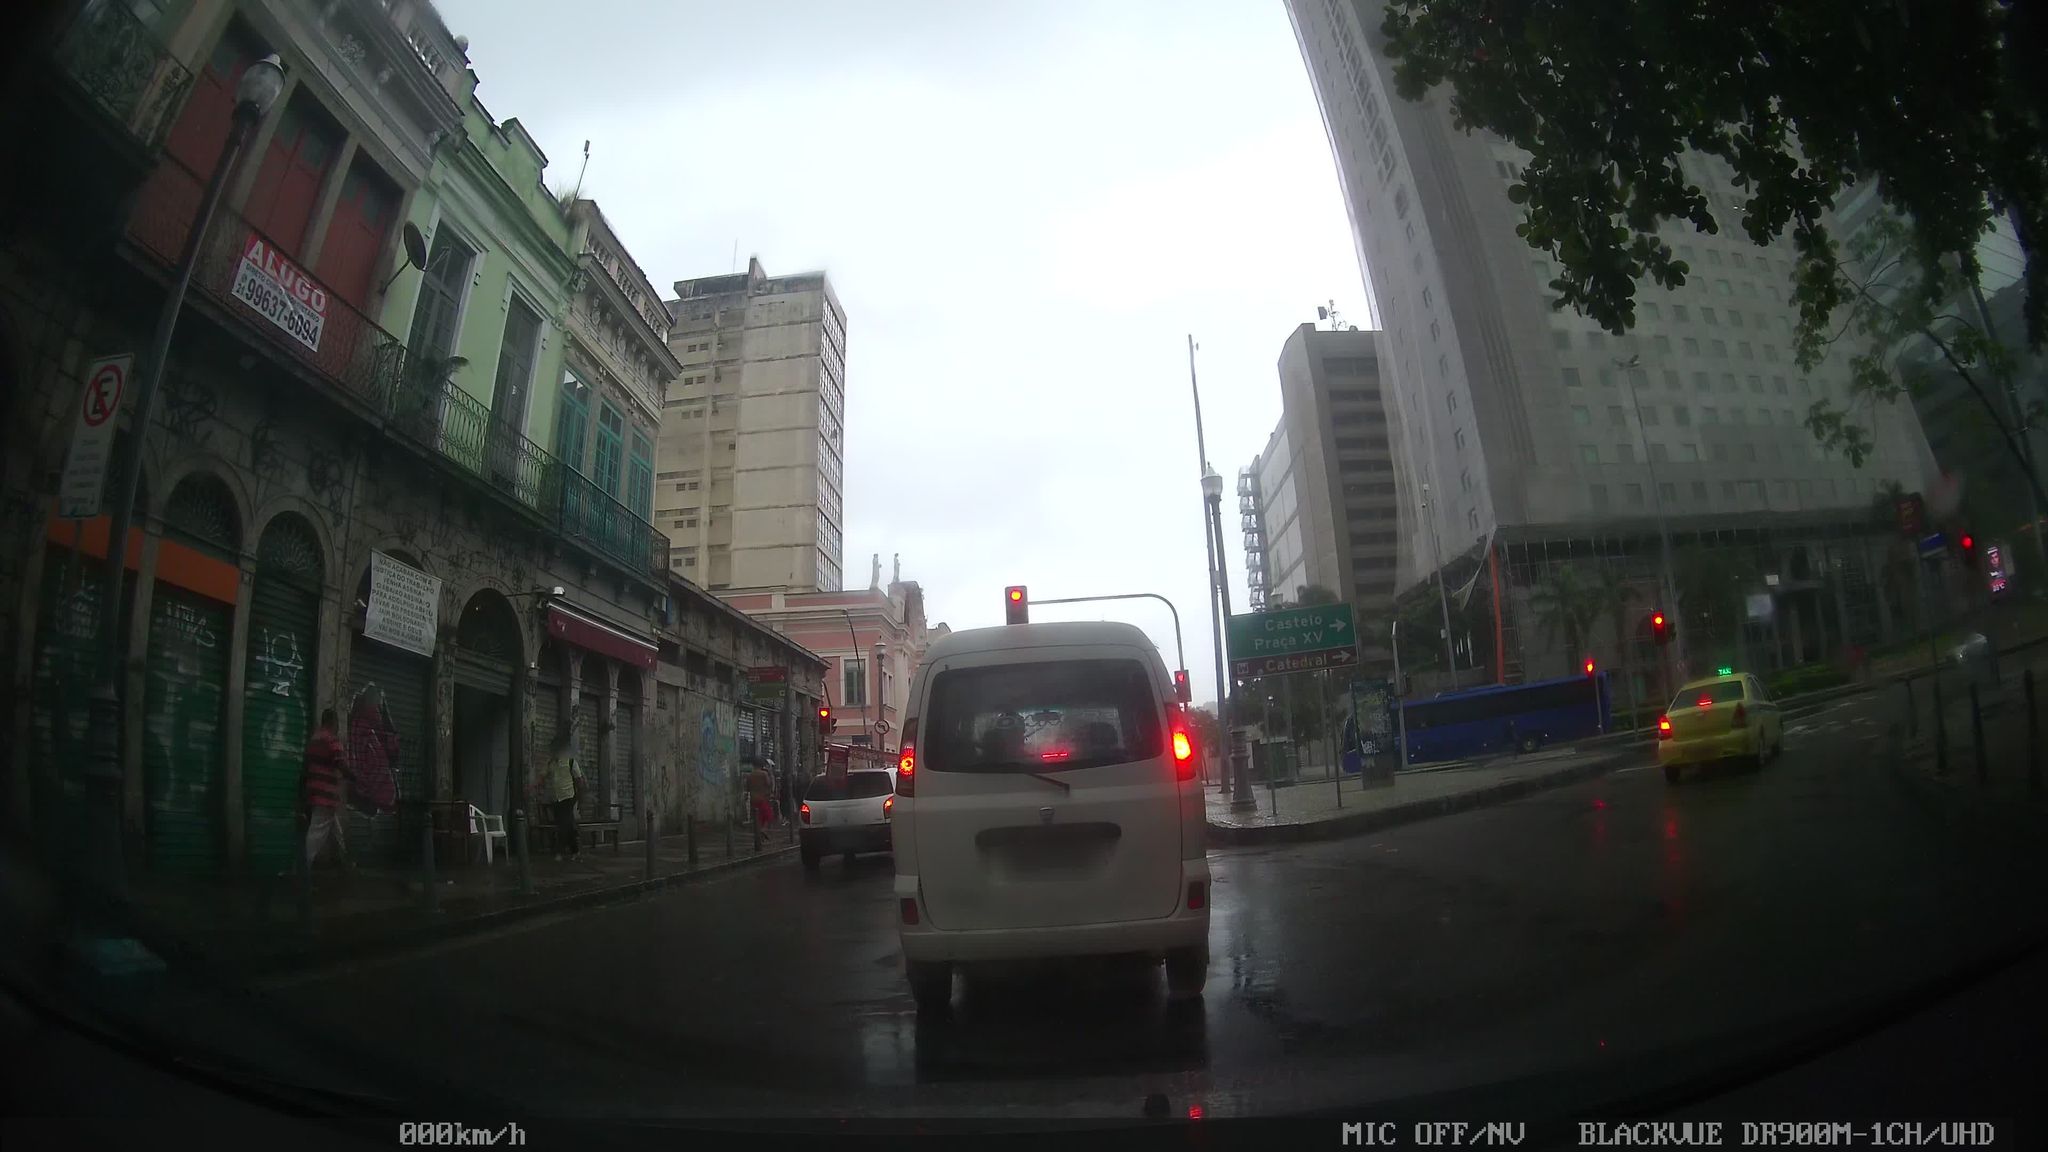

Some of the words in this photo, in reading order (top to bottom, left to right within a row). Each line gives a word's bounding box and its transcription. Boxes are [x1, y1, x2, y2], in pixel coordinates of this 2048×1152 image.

[247, 240, 326, 312] ALUGO
[245, 278, 318, 346] 99637-6094
[403, 593, 430, 607] ASSINAO
[1265, 615, 1322, 632] Castelo
[1254, 636, 1296, 650] Praça
[1303, 631, 1324, 645] XV
[1266, 653, 1327, 672] Catedral
